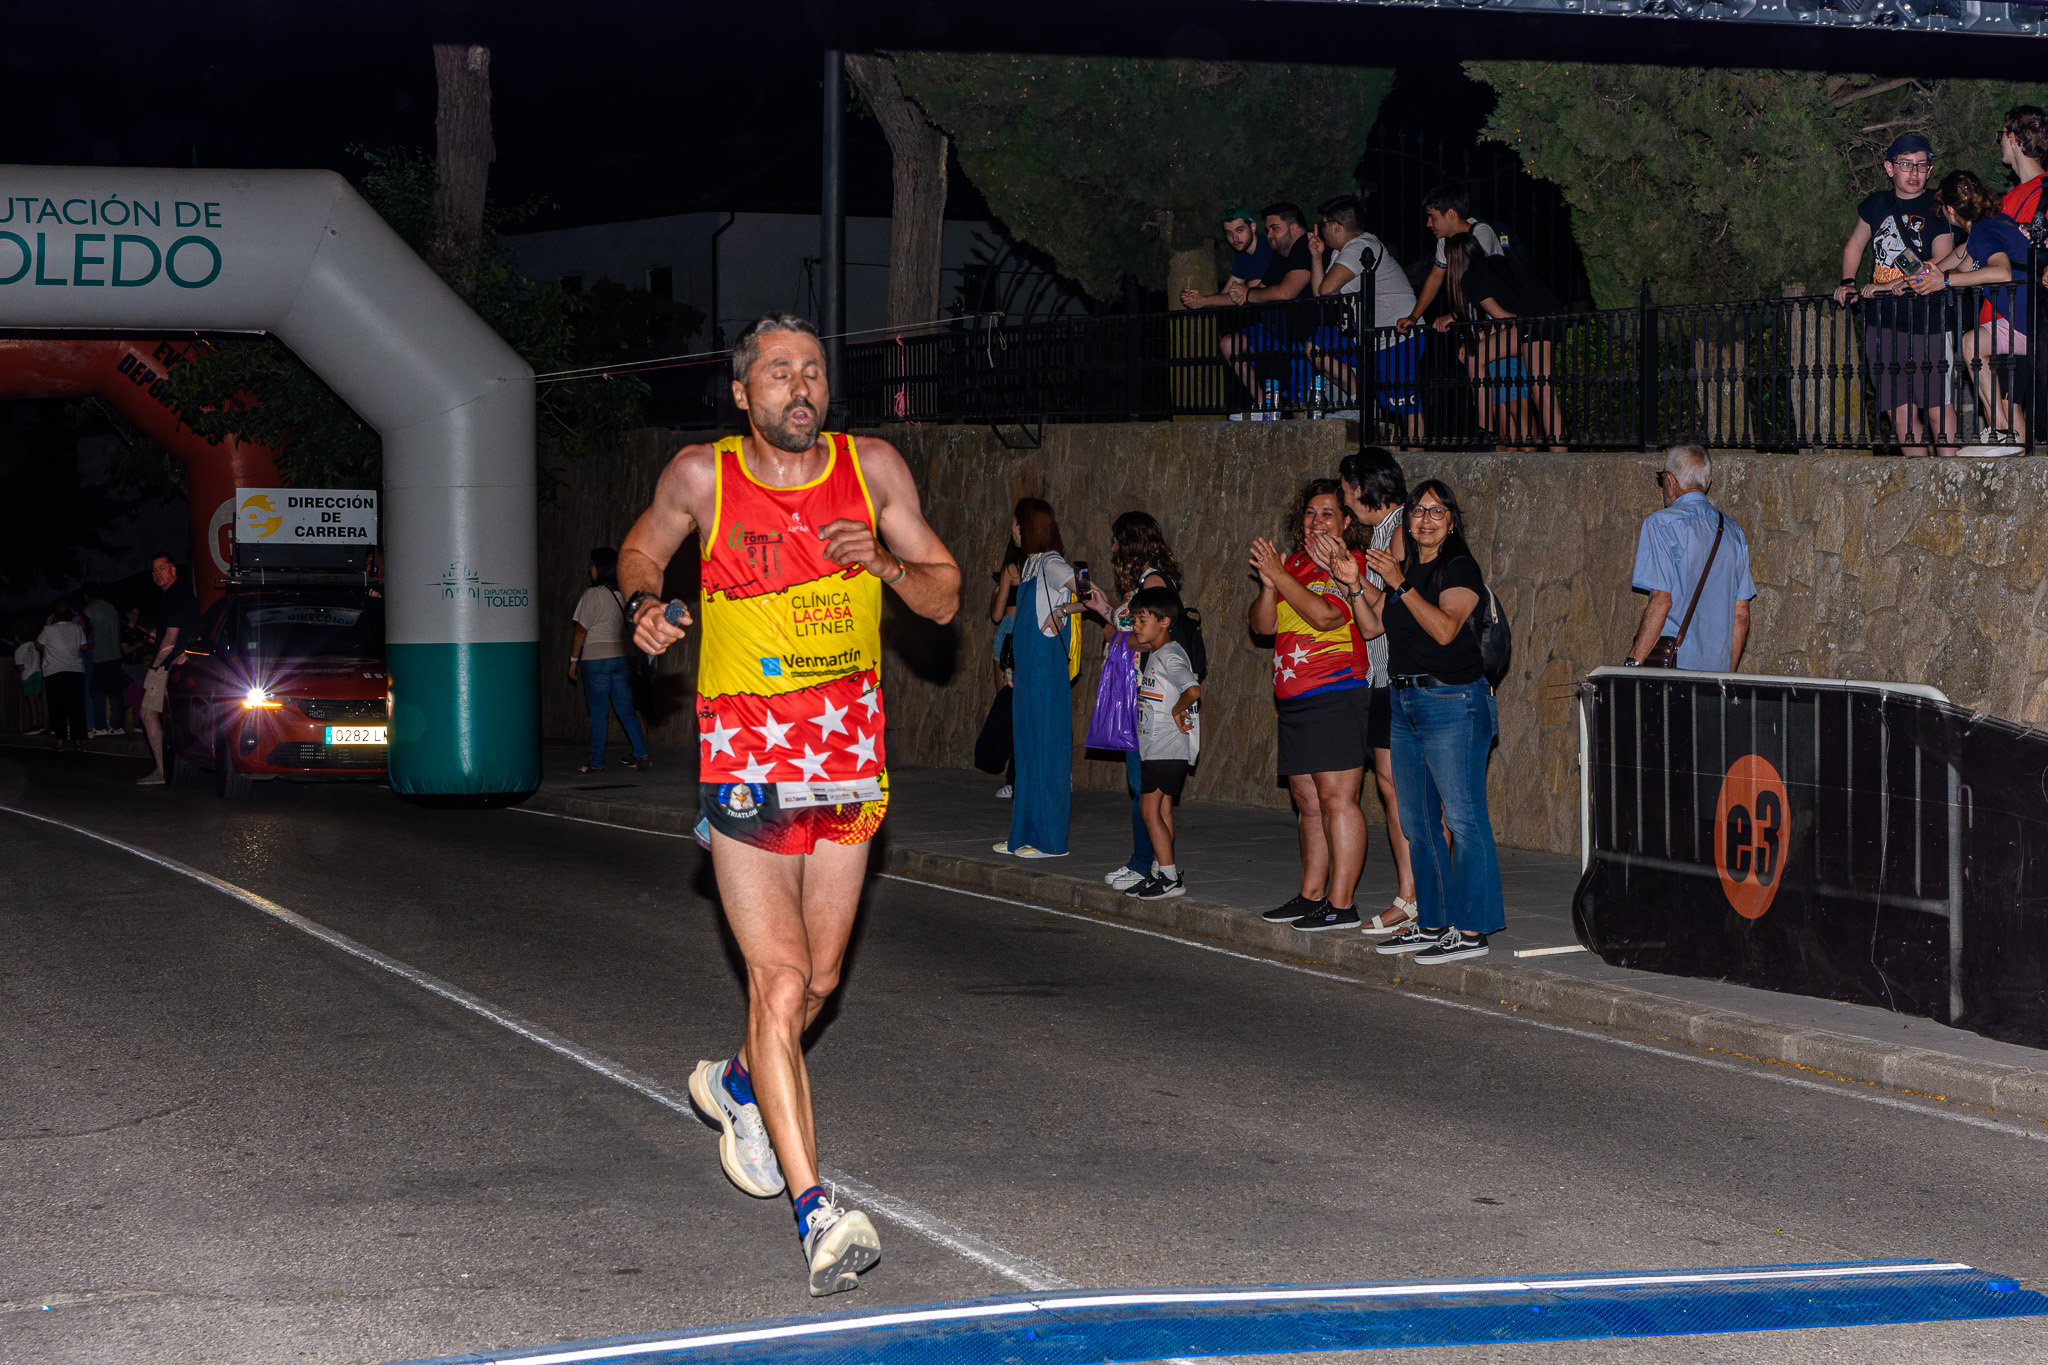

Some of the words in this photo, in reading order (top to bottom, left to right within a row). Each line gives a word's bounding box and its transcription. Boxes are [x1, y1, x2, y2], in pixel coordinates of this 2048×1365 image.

[174, 201, 222, 228] DE
[288, 494, 374, 509] DIRECCIÓN
[321, 512, 341, 523] DE
[294, 525, 368, 538] CARRERA
[484, 596, 529, 608] TOLEDO
[791, 592, 851, 609] CLÍNICA
[793, 605, 853, 623] LACASA
[795, 618, 855, 637] LITNER
[782, 647, 861, 669] Venmartín
[335, 729, 370, 742] 0282
